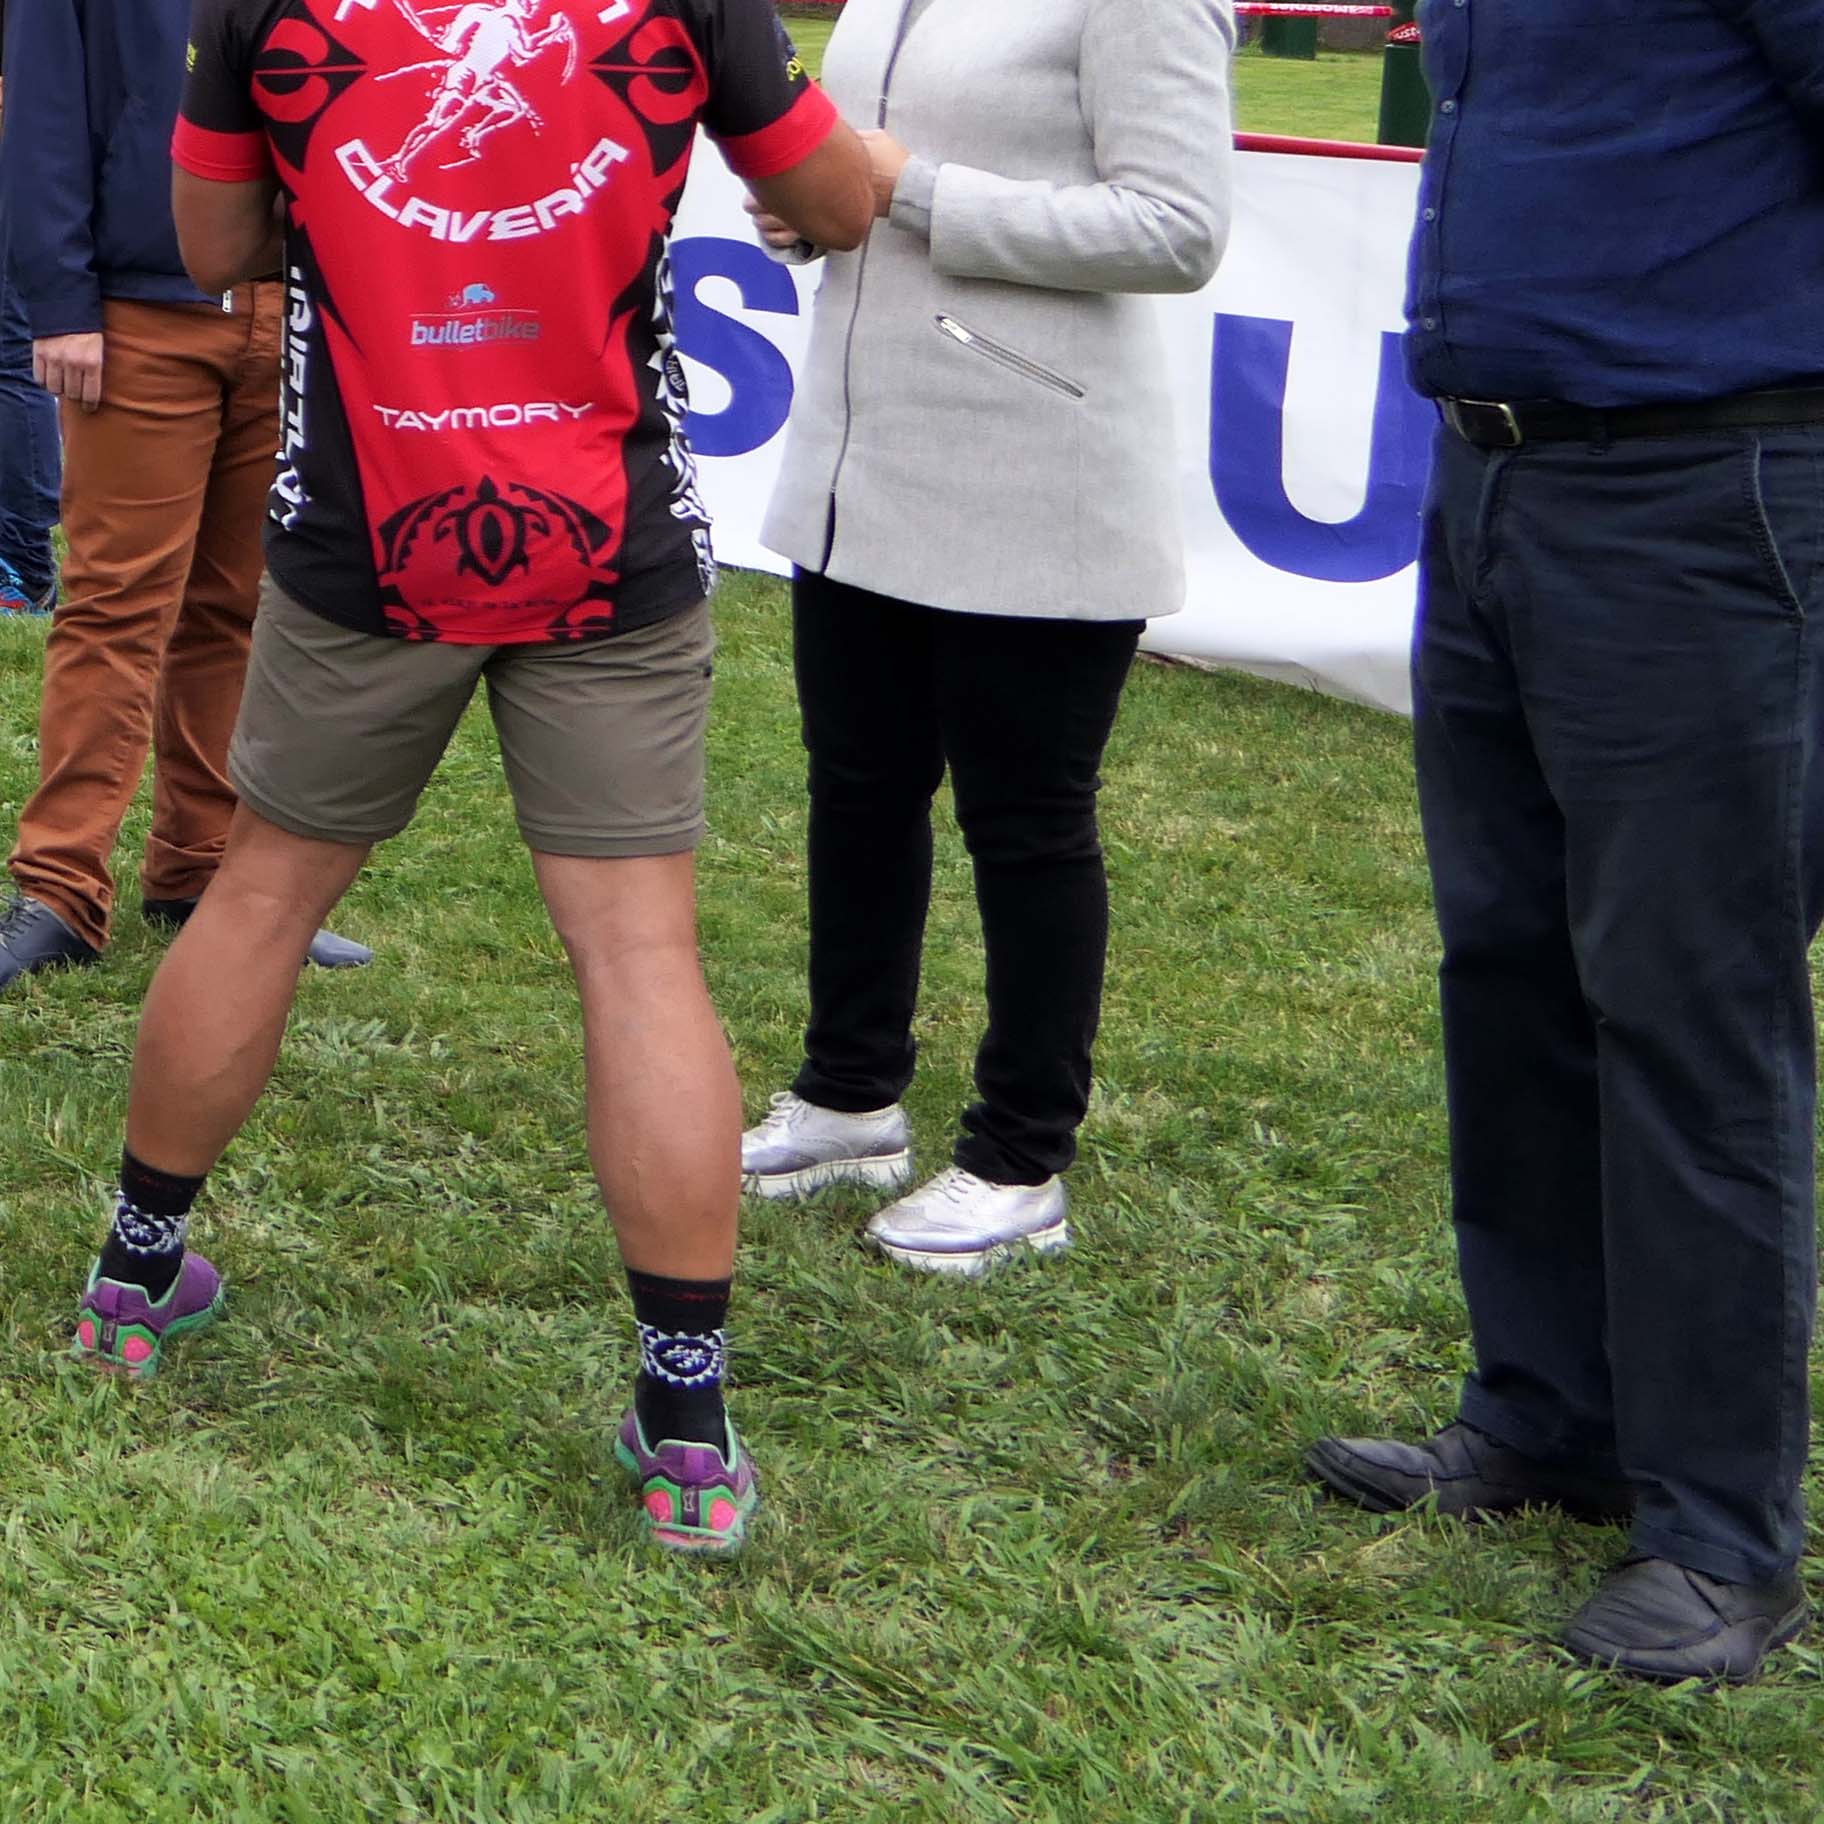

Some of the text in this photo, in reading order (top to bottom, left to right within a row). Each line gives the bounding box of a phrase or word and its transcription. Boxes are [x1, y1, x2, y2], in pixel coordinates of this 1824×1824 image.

[333, 137, 630, 243] CLAVERÍA
[410, 319, 540, 345] bulletbike
[372, 401, 594, 432] TAYMORY
